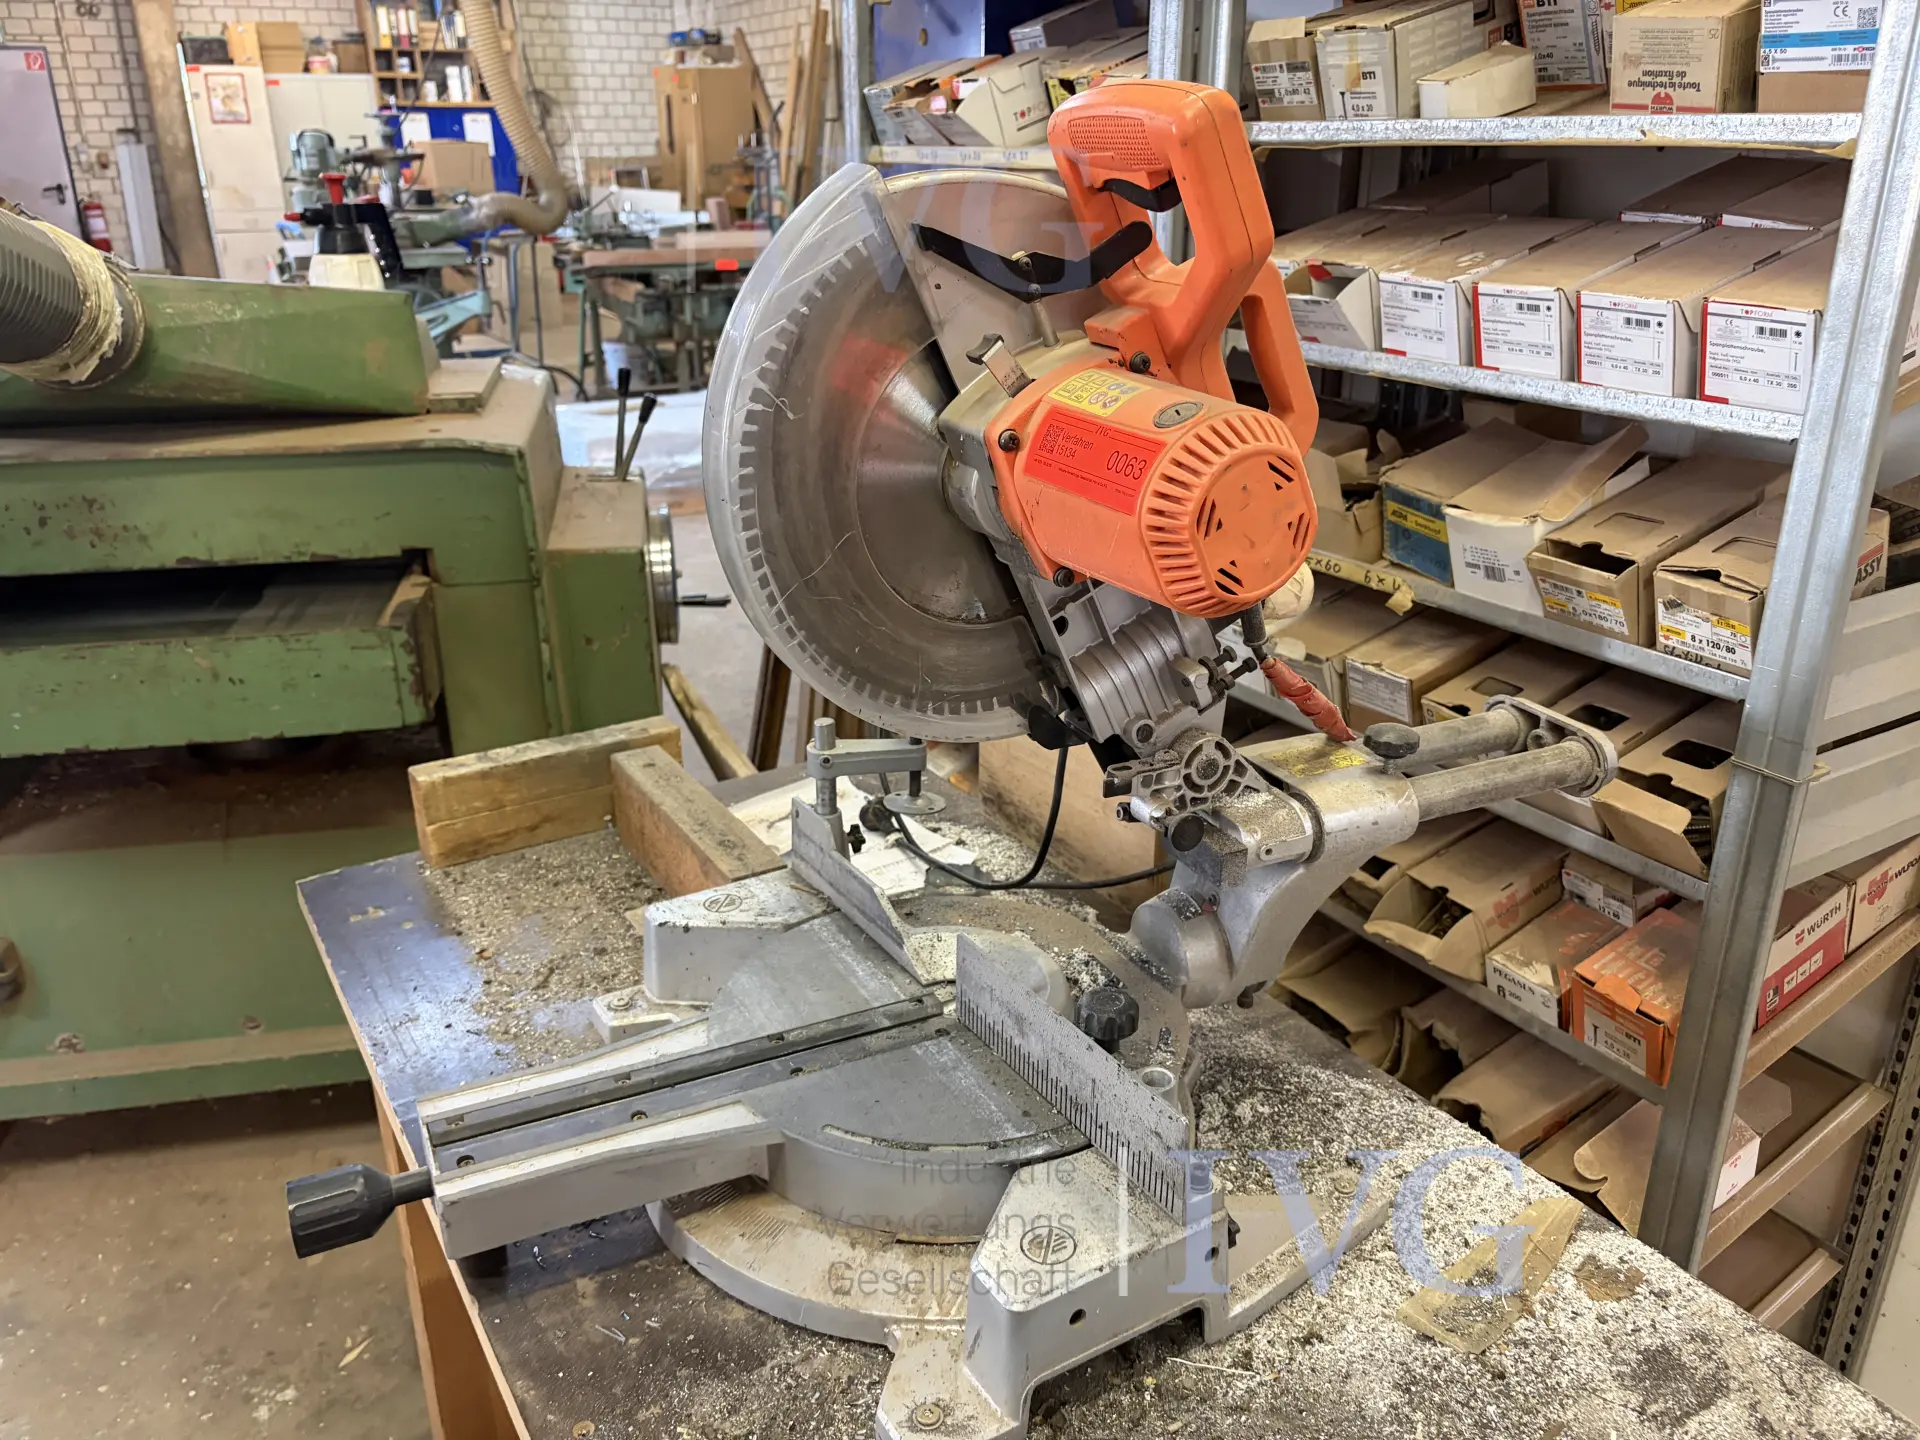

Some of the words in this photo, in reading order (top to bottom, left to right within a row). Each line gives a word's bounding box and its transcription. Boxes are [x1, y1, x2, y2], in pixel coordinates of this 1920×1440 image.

[1362, 71, 1376, 80] BTI
[1642, 69, 1675, 80] fixation
[1676, 70, 1687, 79] de
[1627, 77, 1667, 92] technique
[1668, 81, 1676, 92] la
[1677, 82, 1701, 92] Toute
[1609, 301, 1638, 309] TOPFORM
[1740, 308, 1774, 318] TOPFORM
[1094, 425, 1112, 438] IVG
[1061, 430, 1095, 451] Verfahren
[1055, 443, 1078, 460] 15134
[1106, 450, 1148, 481] 0063
[1854, 553, 1884, 587] ASSY
[1690, 634, 1696, 643] 8
[1706, 639, 1736, 655] 120/80
[1493, 967, 1535, 995] PEGASUS
